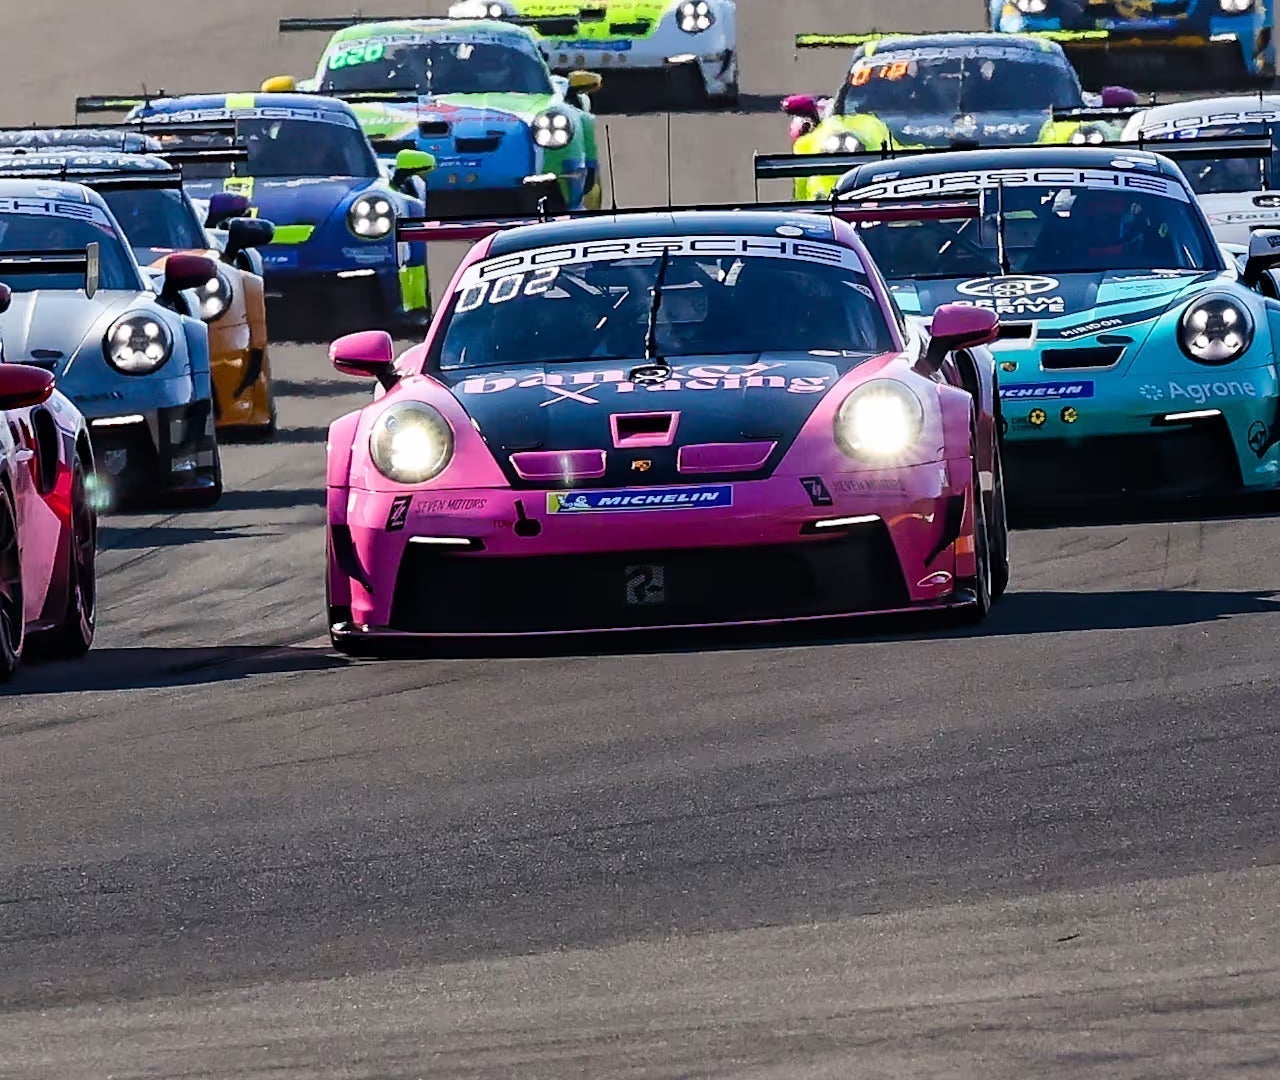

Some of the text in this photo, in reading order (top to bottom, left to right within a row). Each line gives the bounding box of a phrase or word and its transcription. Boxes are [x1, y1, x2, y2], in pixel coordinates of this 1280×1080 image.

[848, 172, 1168, 200] PORSCHE
[480, 240, 842, 279] PORSCHE
[454, 266, 560, 314] 002
[996, 304, 1065, 314] RIVE
[1060, 318, 1123, 338] MIRIDON
[999, 384, 1083, 397] ICHELIN
[1170, 381, 1257, 404] Agrone
[416, 498, 445, 514] SEVEN
[447, 497, 488, 511] MOTORS
[597, 491, 719, 506] MICHELIN
